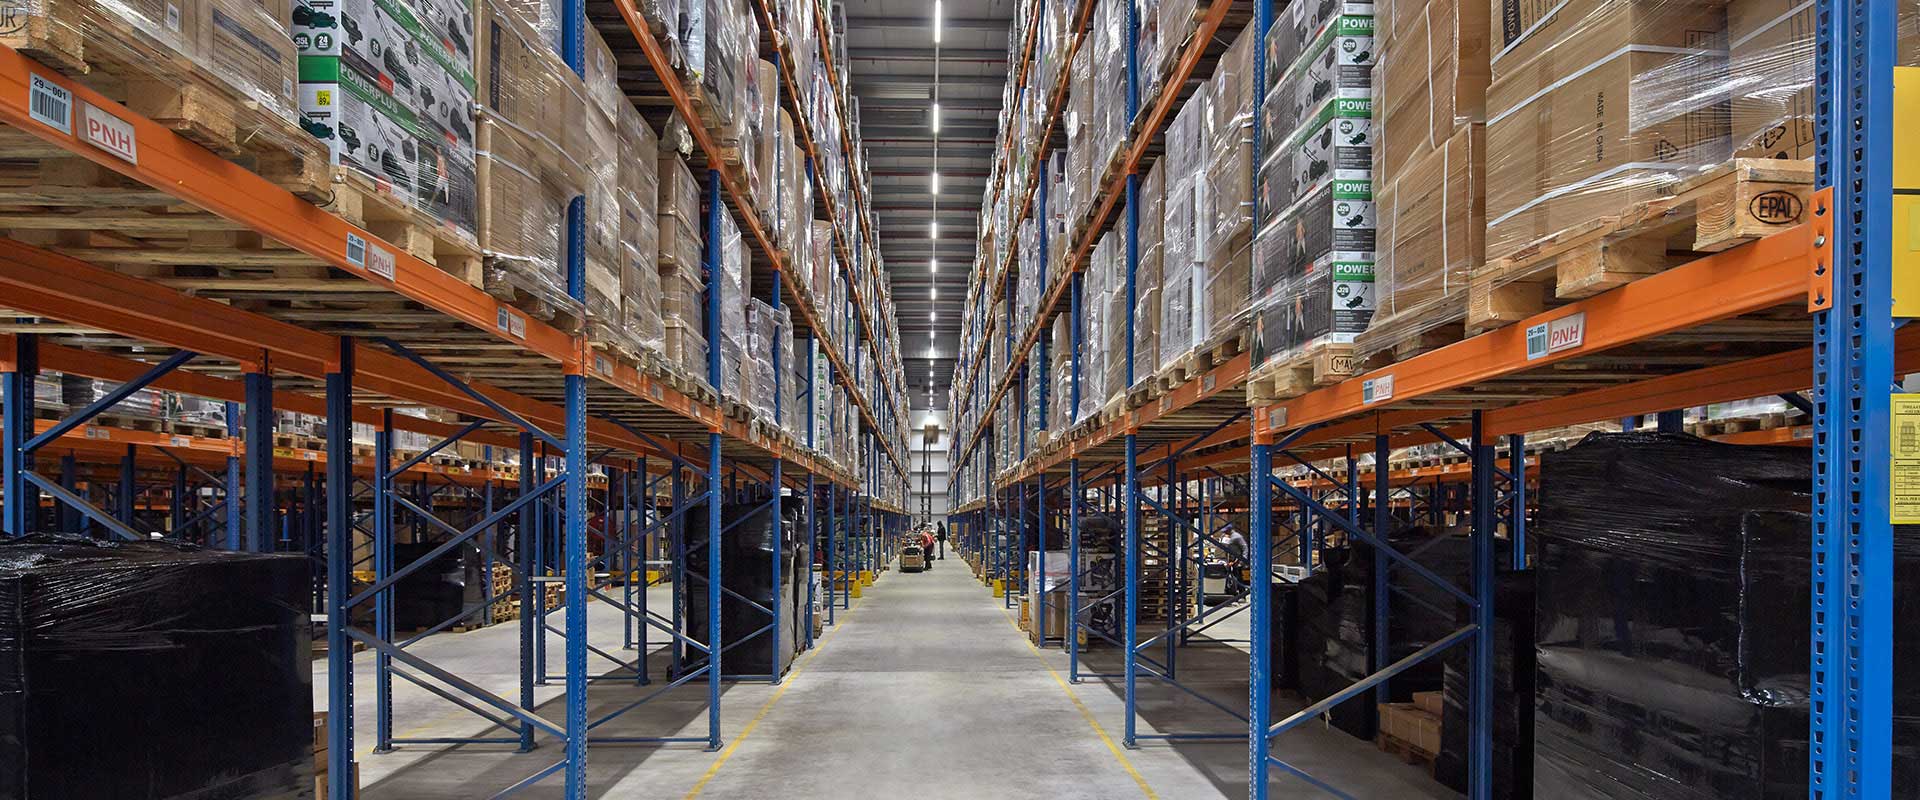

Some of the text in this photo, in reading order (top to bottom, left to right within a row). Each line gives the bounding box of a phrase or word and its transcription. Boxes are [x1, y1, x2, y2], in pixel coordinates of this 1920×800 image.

[341, 62, 399, 114] POWERPLUS
[88, 118, 132, 154] PNH
[1336, 183, 1372, 192] POWE
[1758, 196, 1794, 219] EPAL
[372, 253, 392, 274] PNH
[1551, 324, 1579, 347] PNH
